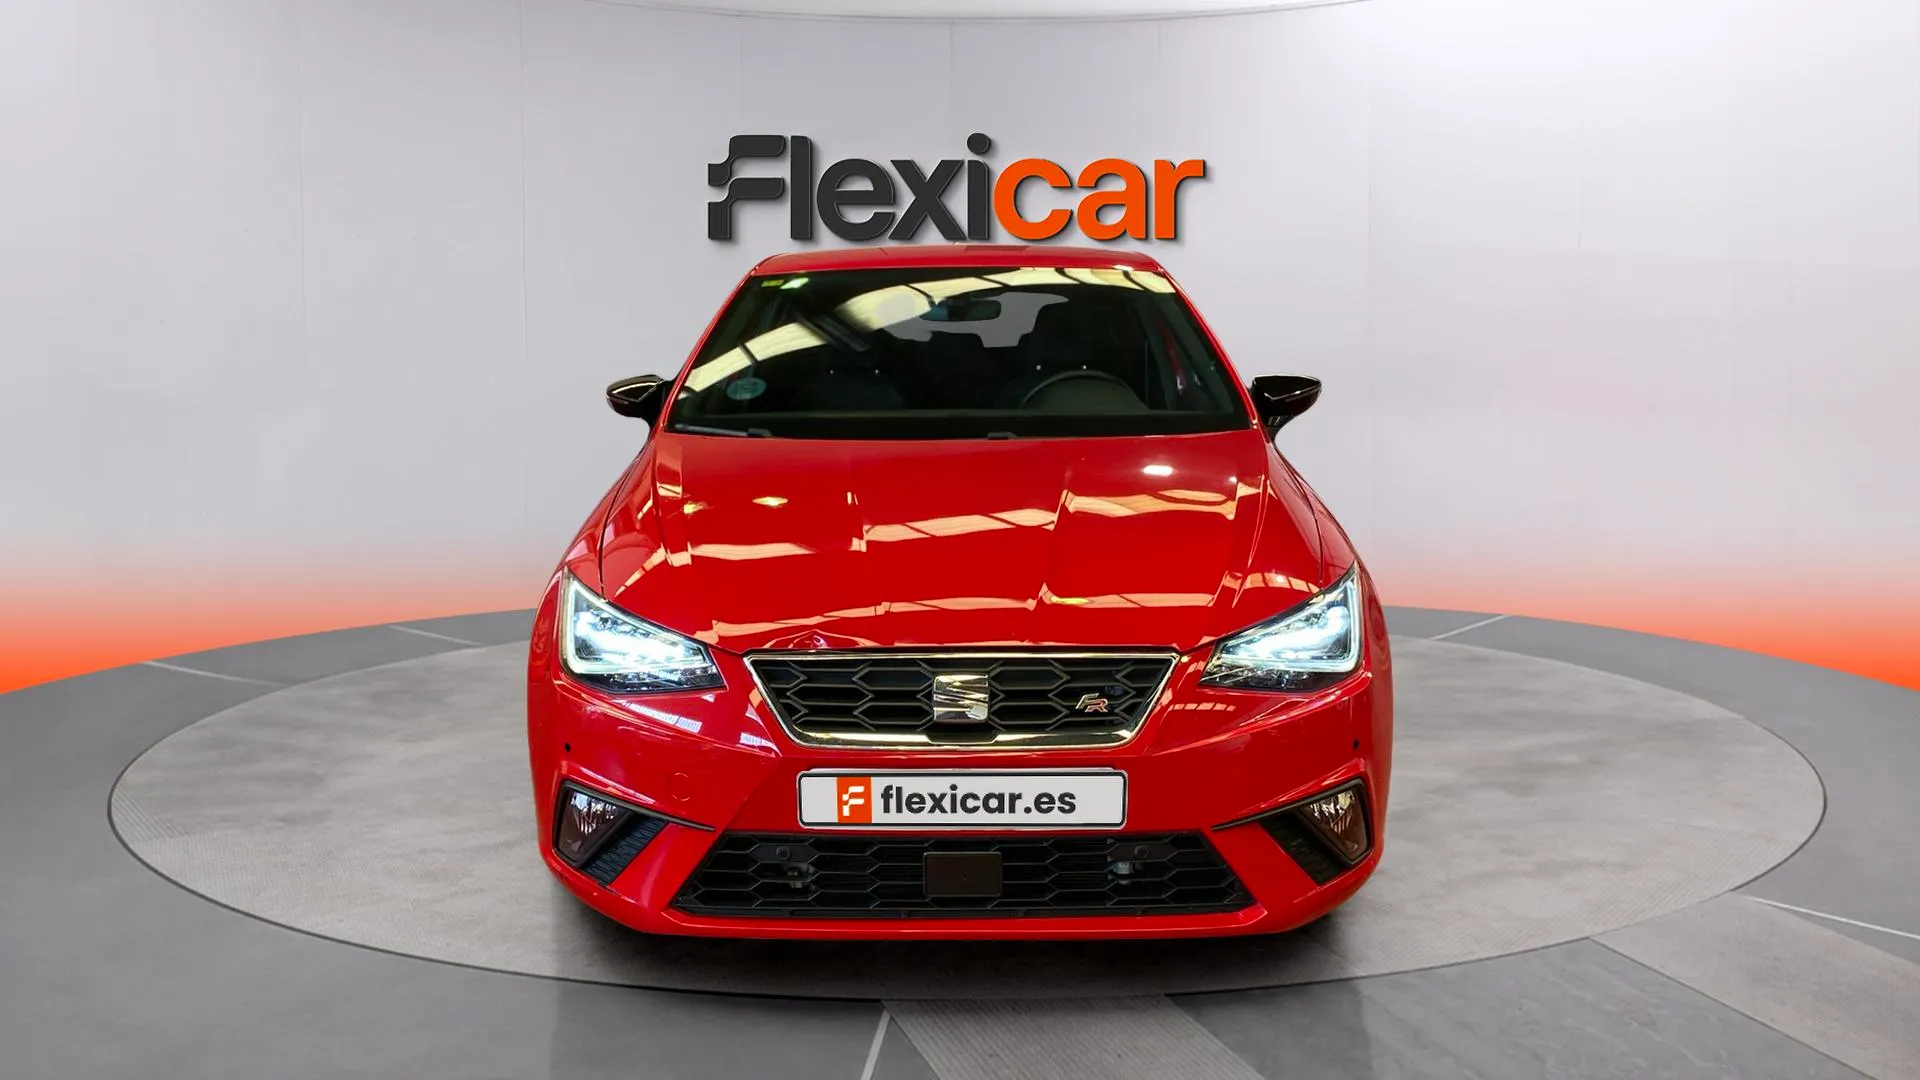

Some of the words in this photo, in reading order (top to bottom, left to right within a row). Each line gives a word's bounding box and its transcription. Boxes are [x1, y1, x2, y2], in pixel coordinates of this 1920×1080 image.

[708, 132, 1206, 241] Flexicar
[1075, 692, 1109, 713] FR
[881, 784, 1077, 814] flexicar.es
